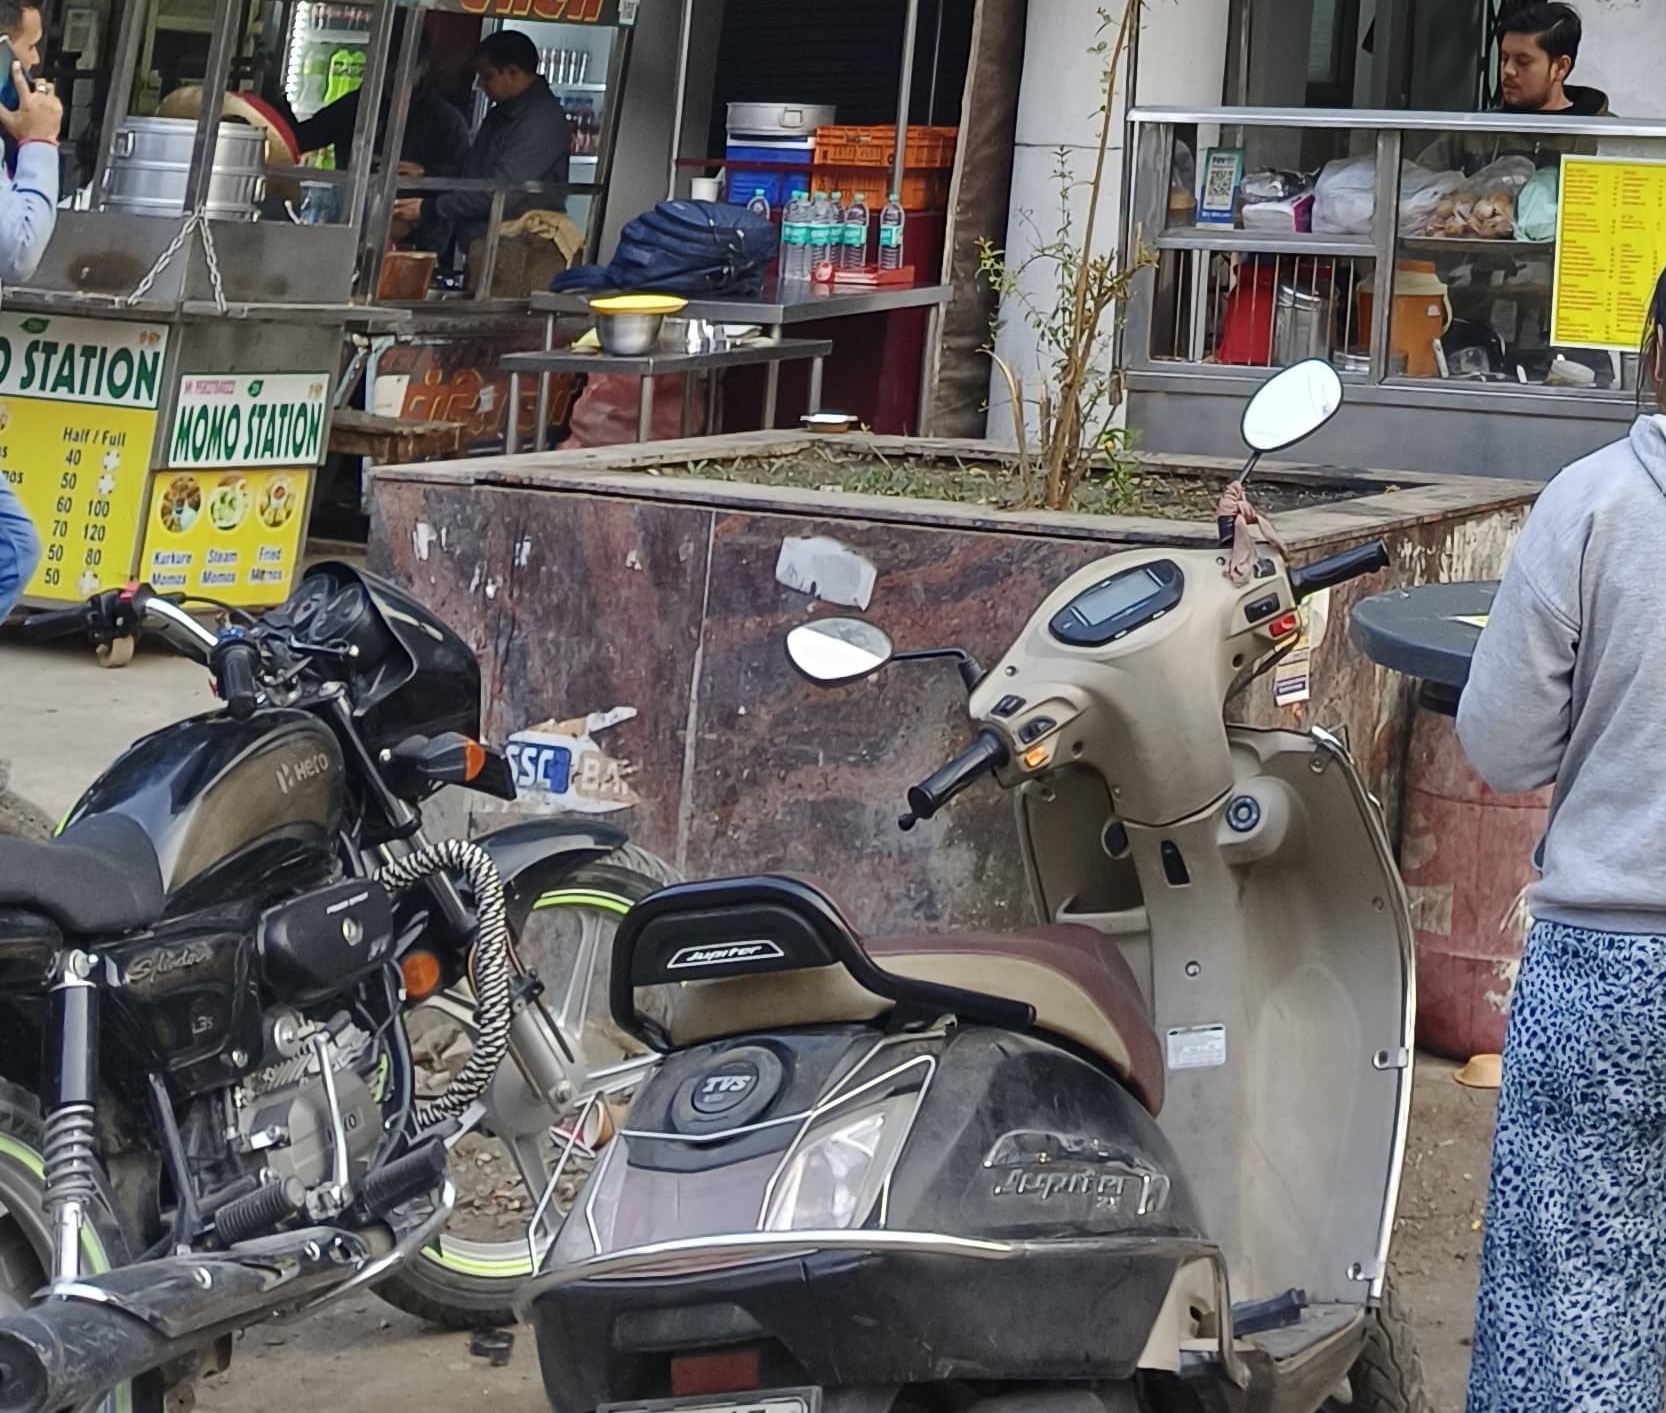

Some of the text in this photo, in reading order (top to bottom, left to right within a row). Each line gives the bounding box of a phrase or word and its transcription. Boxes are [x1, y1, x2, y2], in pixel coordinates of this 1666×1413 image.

[63, 427, 126, 447] Half Full
[172, 403, 322, 463] MOMO STATION
[53, 521, 105, 541] 70 120
[703, 1074, 752, 1095] TVS
